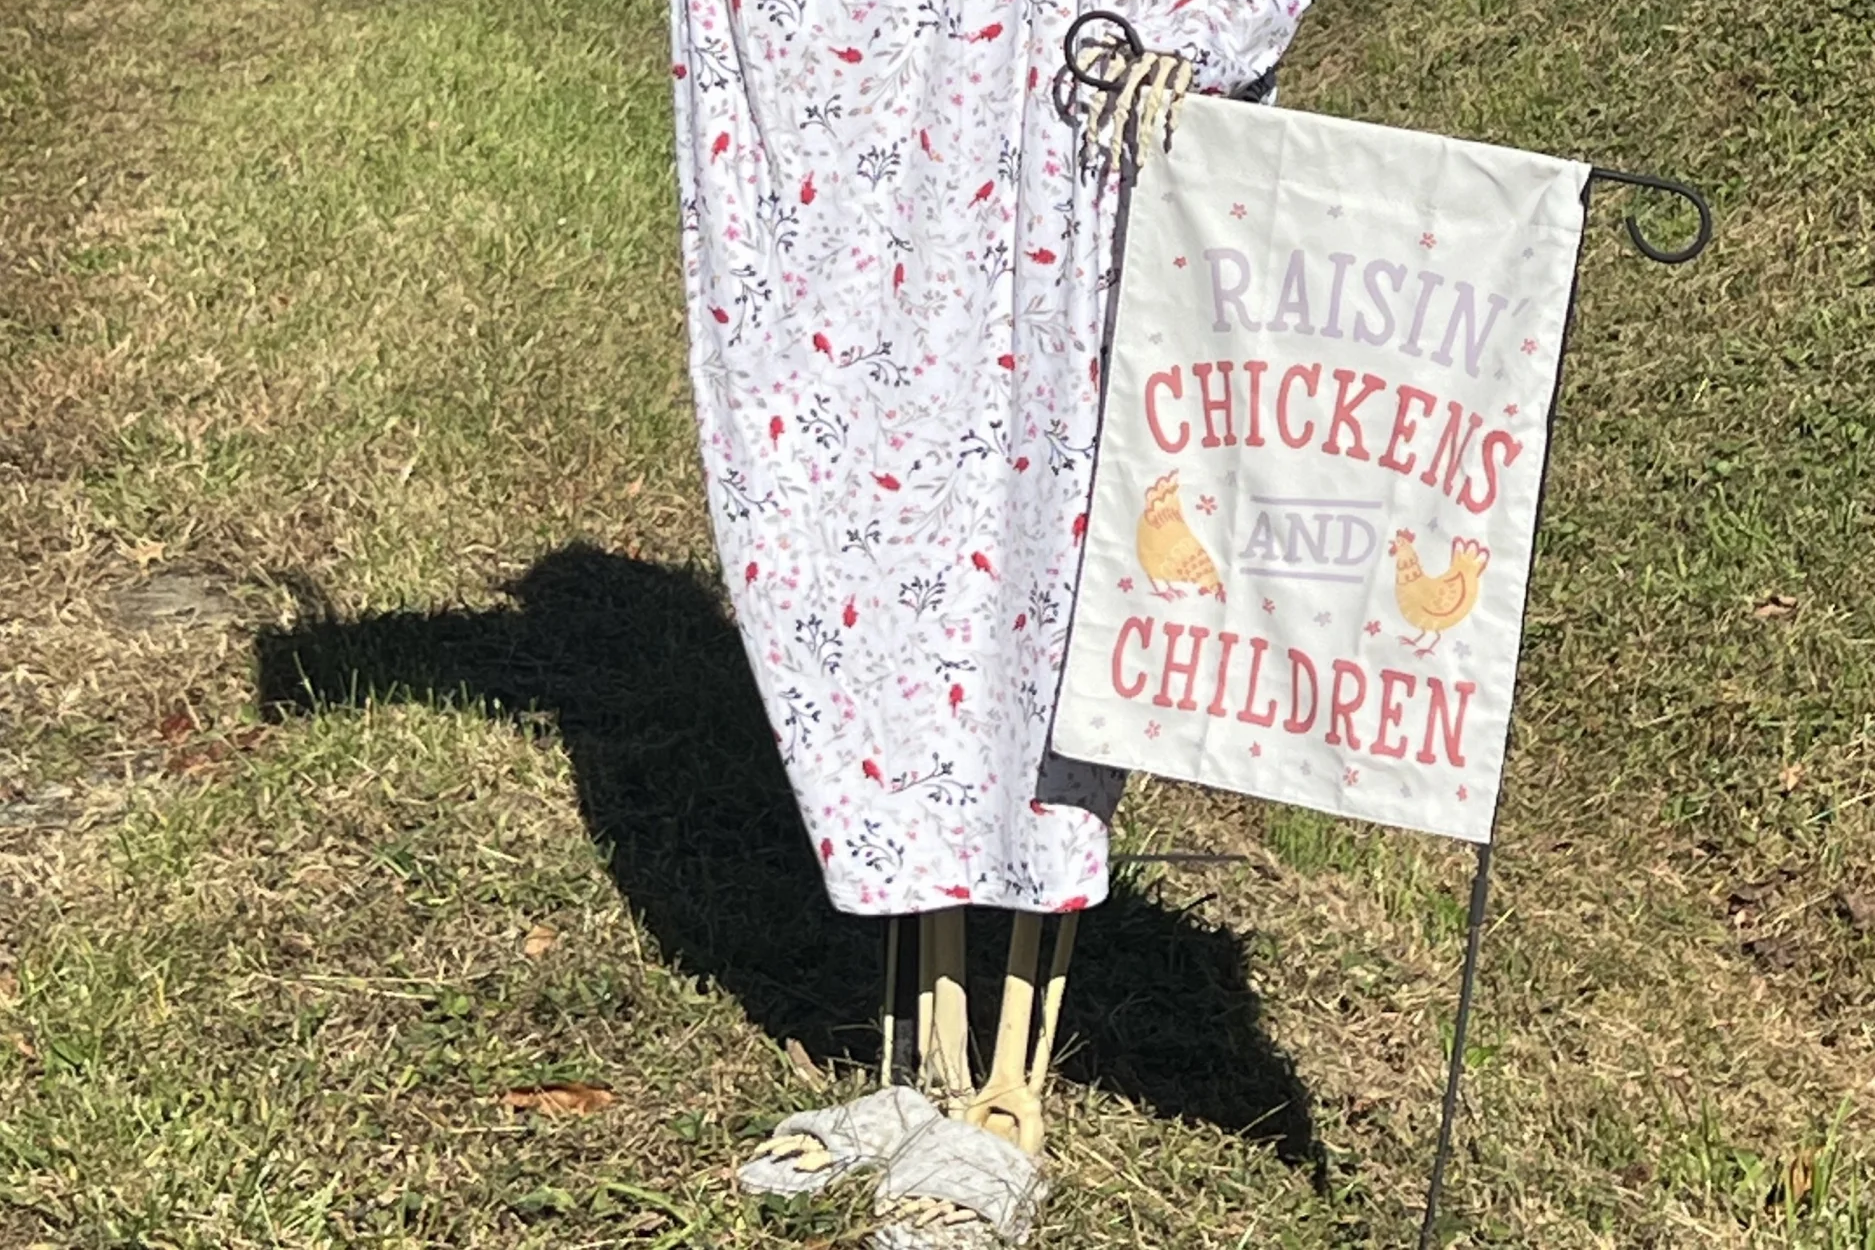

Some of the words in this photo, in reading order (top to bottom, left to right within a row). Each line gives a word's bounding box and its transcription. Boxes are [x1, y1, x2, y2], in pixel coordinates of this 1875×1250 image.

[1203, 247, 1529, 378] RAISIN'
[1145, 360, 1523, 514] CHICKENS
[1238, 510, 1377, 565] AND
[1111, 616, 1475, 767] CHILDREN
